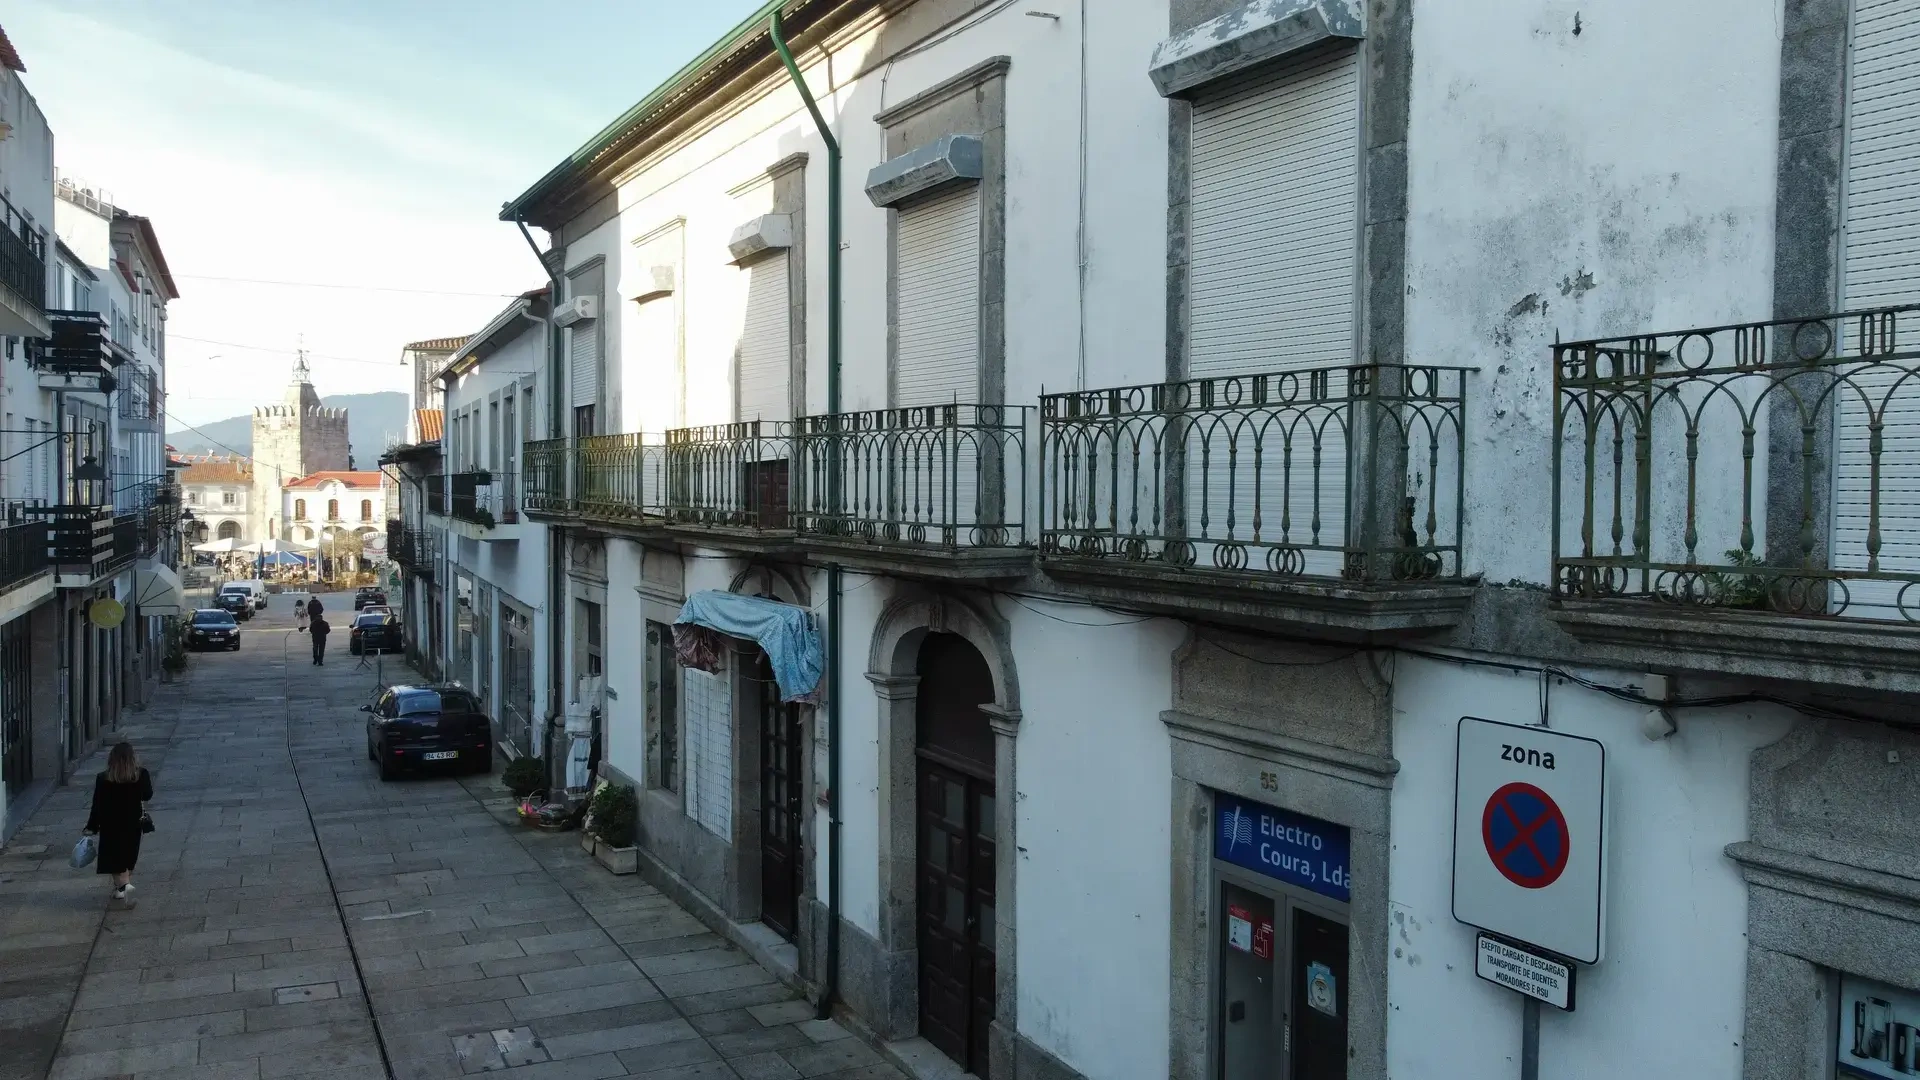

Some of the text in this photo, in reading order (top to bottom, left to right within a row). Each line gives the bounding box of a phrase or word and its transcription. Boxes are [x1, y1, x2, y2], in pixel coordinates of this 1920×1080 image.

[1501, 743, 1555, 770] zona
[1260, 771, 1278, 792] 55
[1260, 815, 1322, 851] Electro
[1260, 843, 1316, 883] Coura,
[1481, 940, 1501, 954] EXEPTO
[1502, 947, 1525, 963] CARGAS
[1525, 955, 1530, 964] E
[1487, 954, 1522, 976] TRANSPORTE
[1522, 968, 1531, 979] DE
[1495, 971, 1549, 998] MORADORES E RSU
